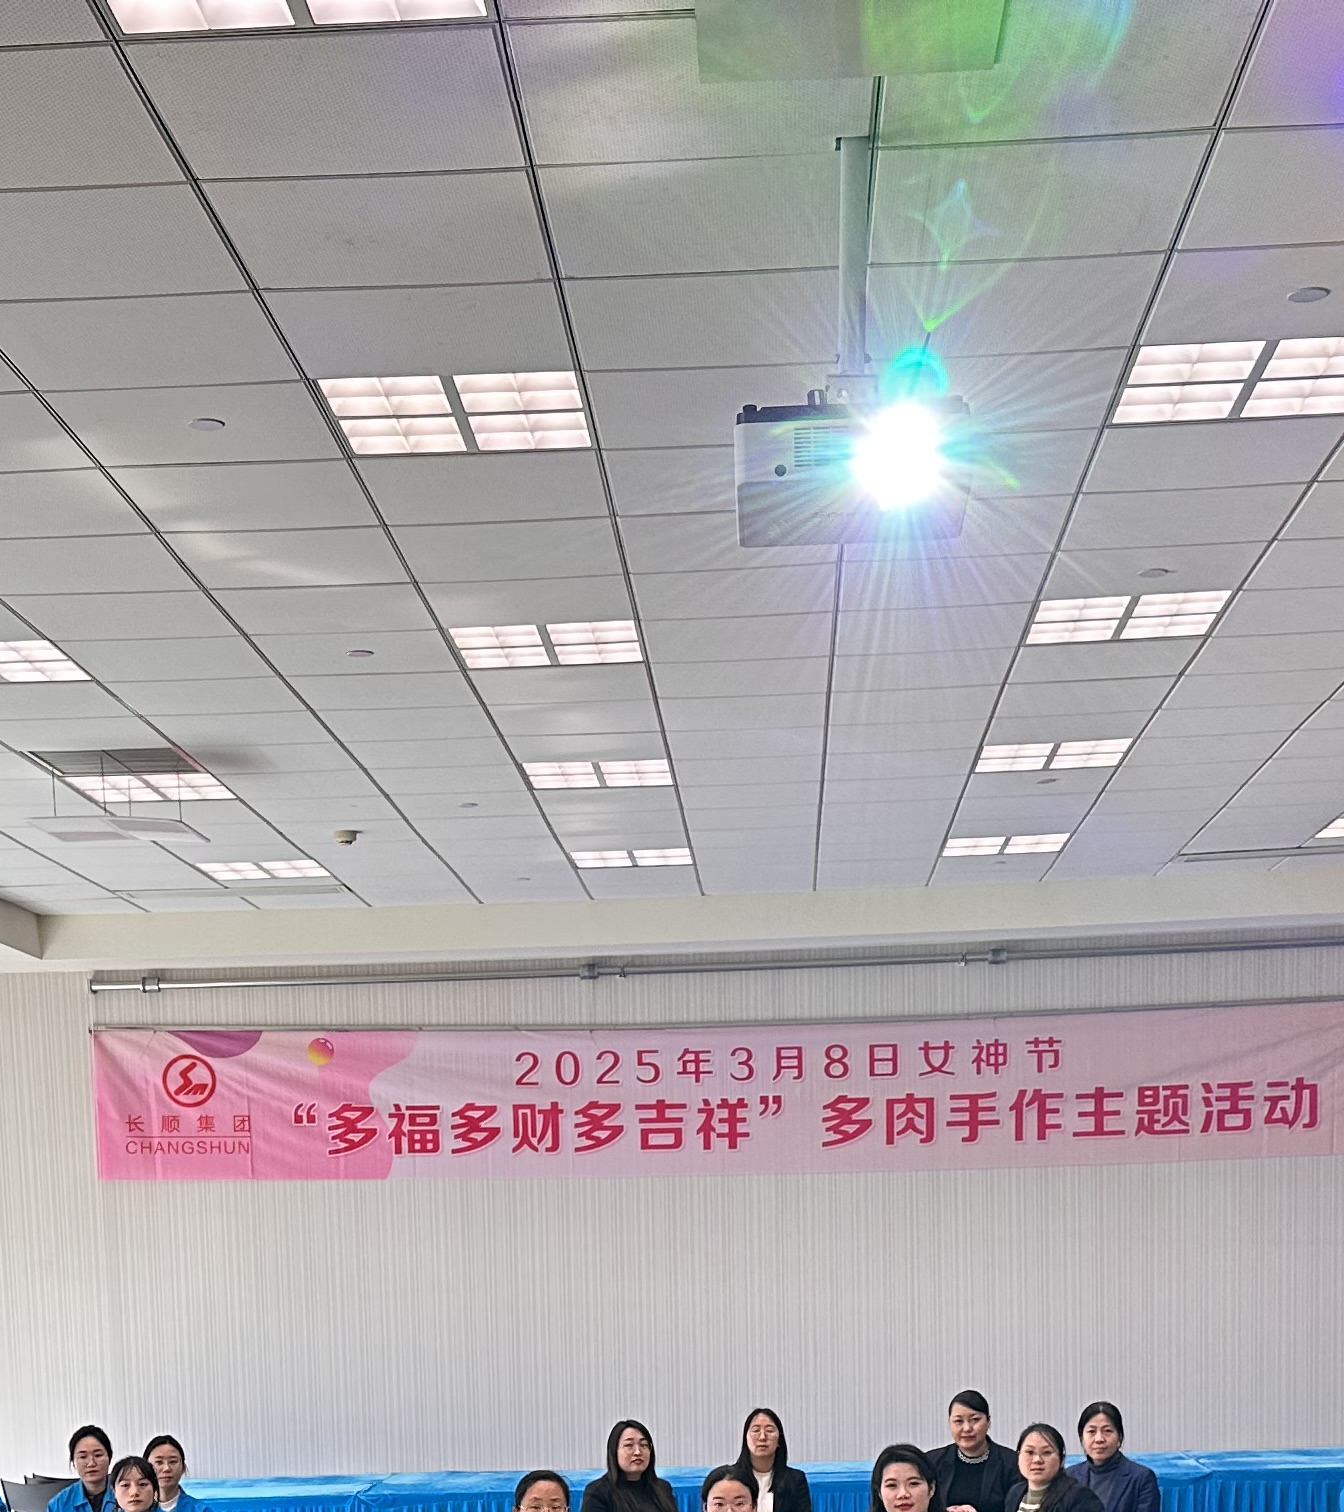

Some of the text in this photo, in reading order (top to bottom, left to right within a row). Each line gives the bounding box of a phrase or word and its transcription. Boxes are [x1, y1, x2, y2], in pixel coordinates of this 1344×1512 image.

[514, 1036, 1063, 1087] 2025年3月8日女神节
[125, 1114, 250, 1133] 长顺集团
[821, 1076, 1319, 1149] 多肉手作主题活动
[125, 1140, 250, 1156] CHANGSHUN
